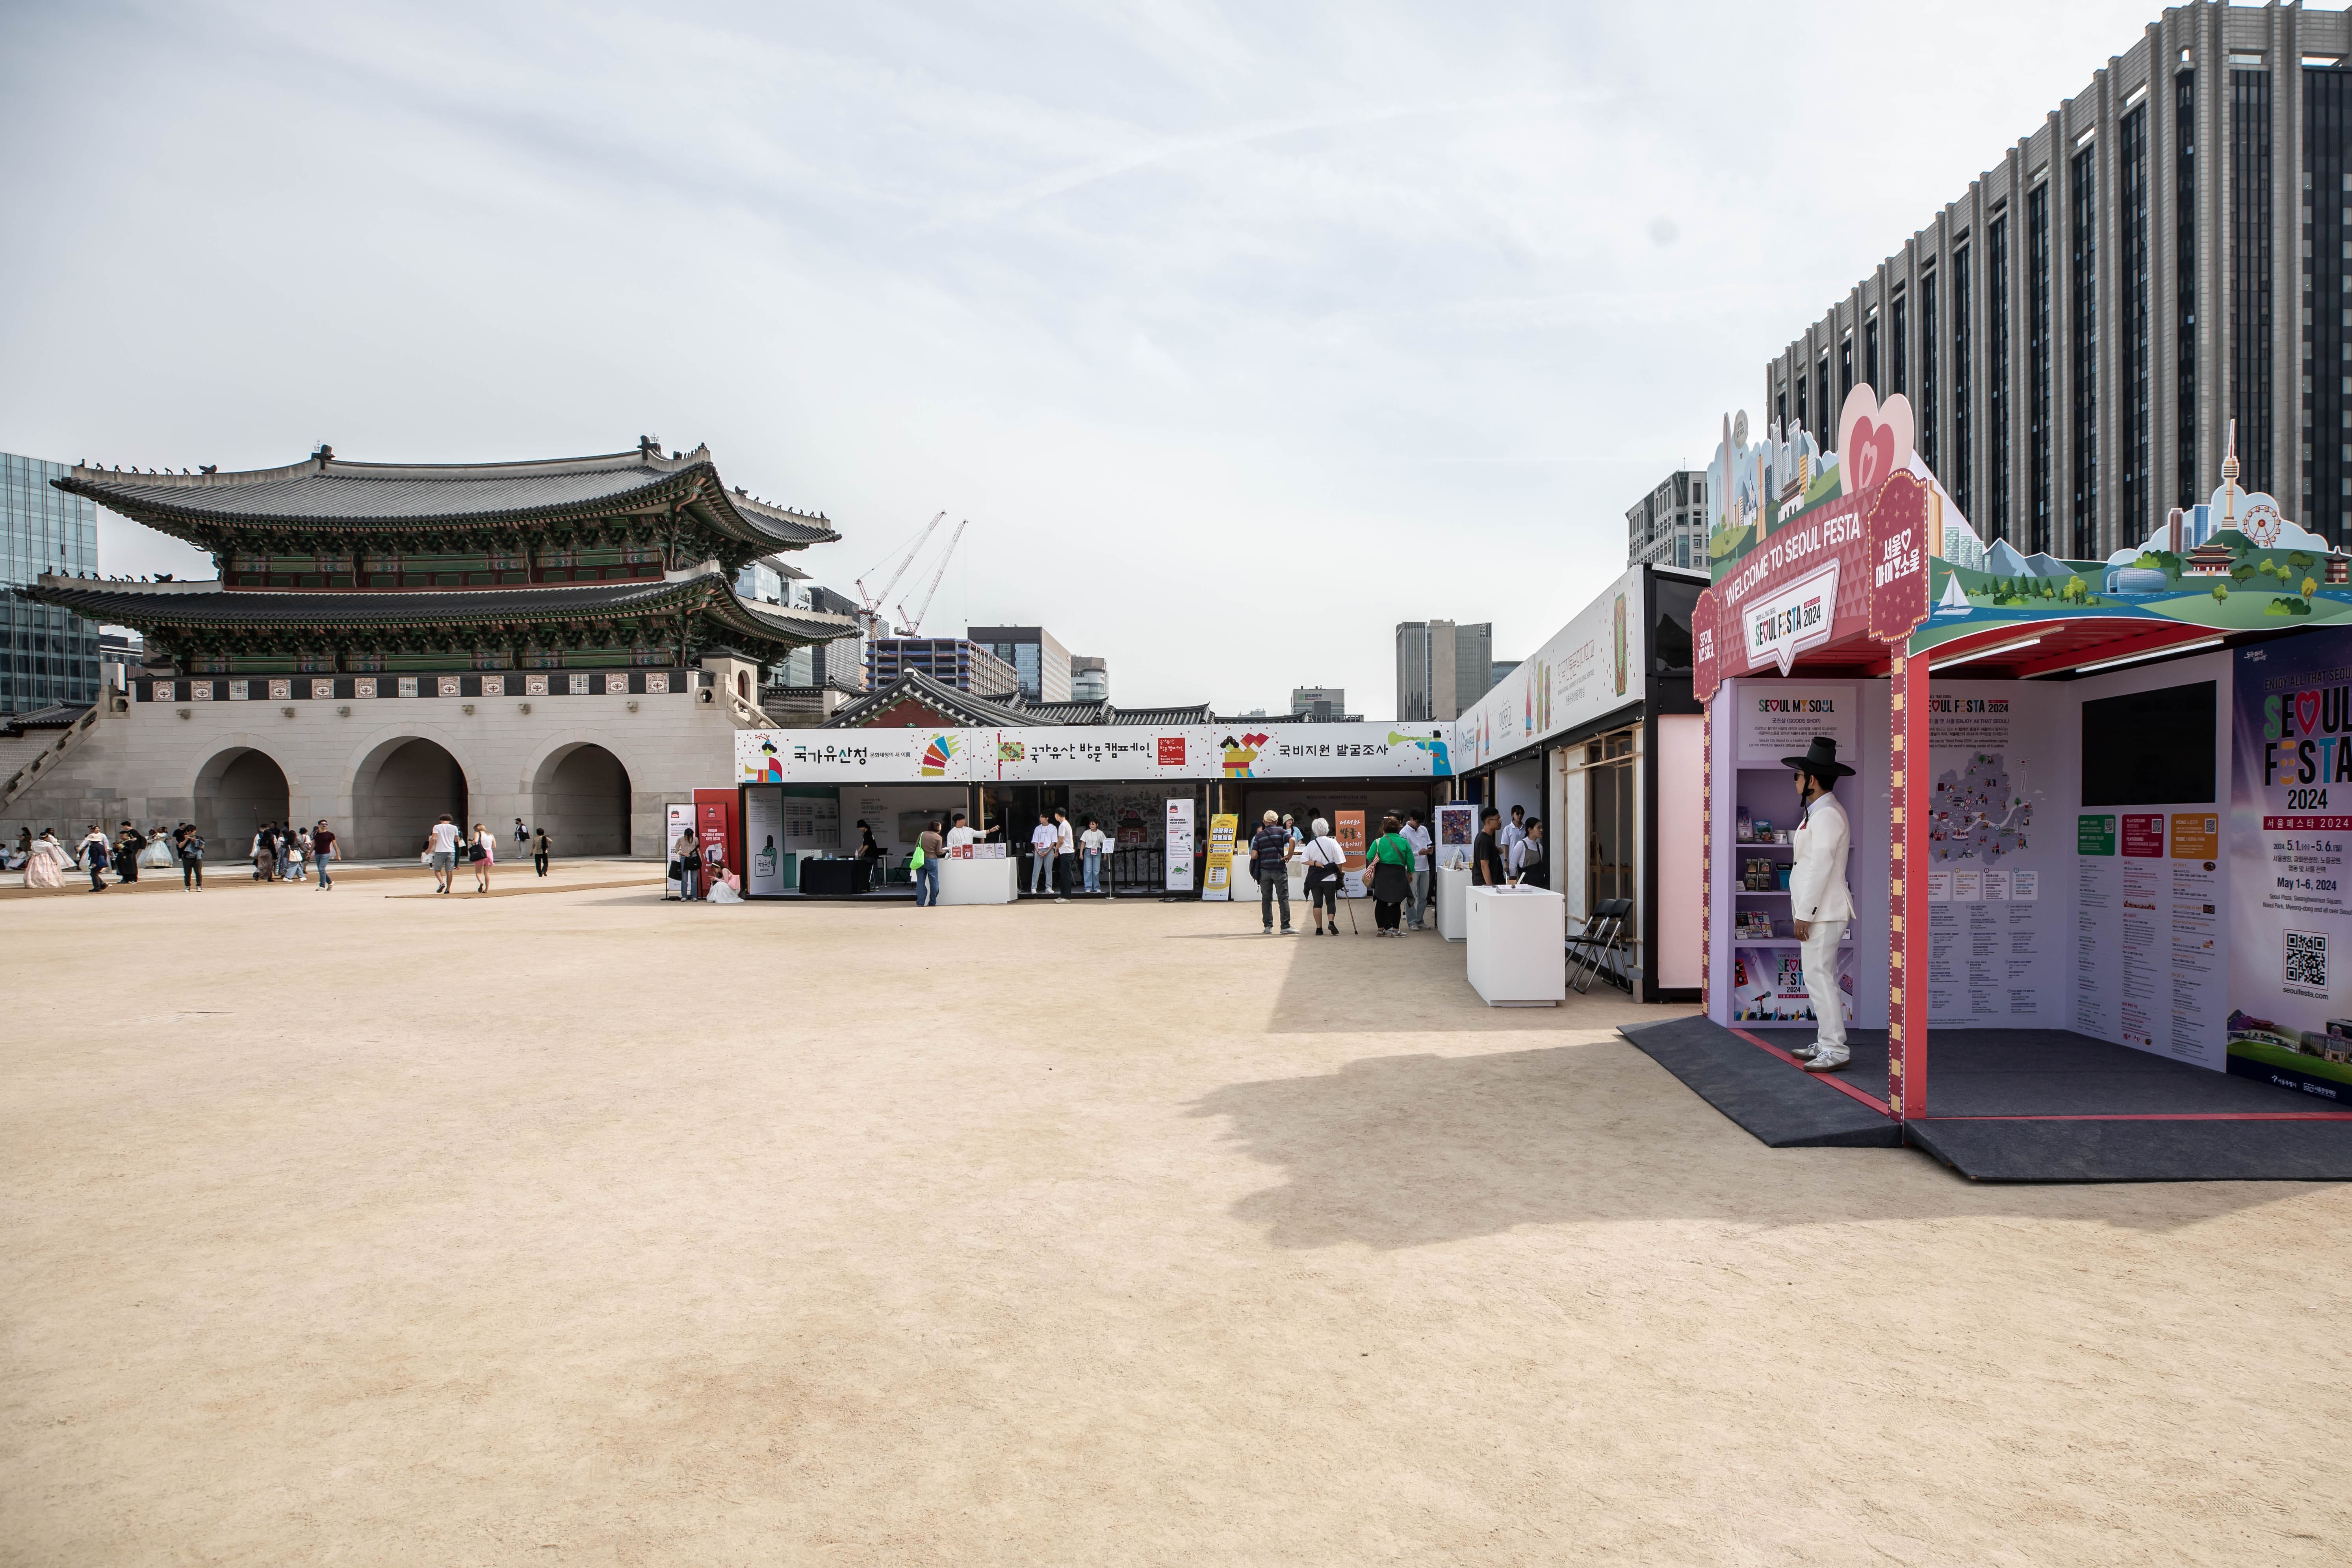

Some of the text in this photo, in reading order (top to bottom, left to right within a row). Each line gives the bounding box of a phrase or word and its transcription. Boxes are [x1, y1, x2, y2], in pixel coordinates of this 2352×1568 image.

[1883, 534, 1901, 562] 서울
[1725, 512, 1860, 608] WELCOME TO SEOUL FESTA
[1804, 604, 1821, 627] 2024
[2265, 671, 2326, 690] ENJOY ALL THAT
[1988, 704, 2009, 713] 2024
[794, 745, 867, 765] 국가유산청
[1030, 742, 1152, 763] 국가유산 방문 캠페인
[1279, 744, 1389, 757] 국비지원 발굴조사
[2287, 789, 2328, 809] 2024
[2267, 818, 2349, 828] 서울페스타 2024
[2277, 877, 2337, 891] May 1~6, 2024
[2285, 904, 2313, 913] Myeong-dong
[2283, 987, 2328, 1000] seoulfesta.com
